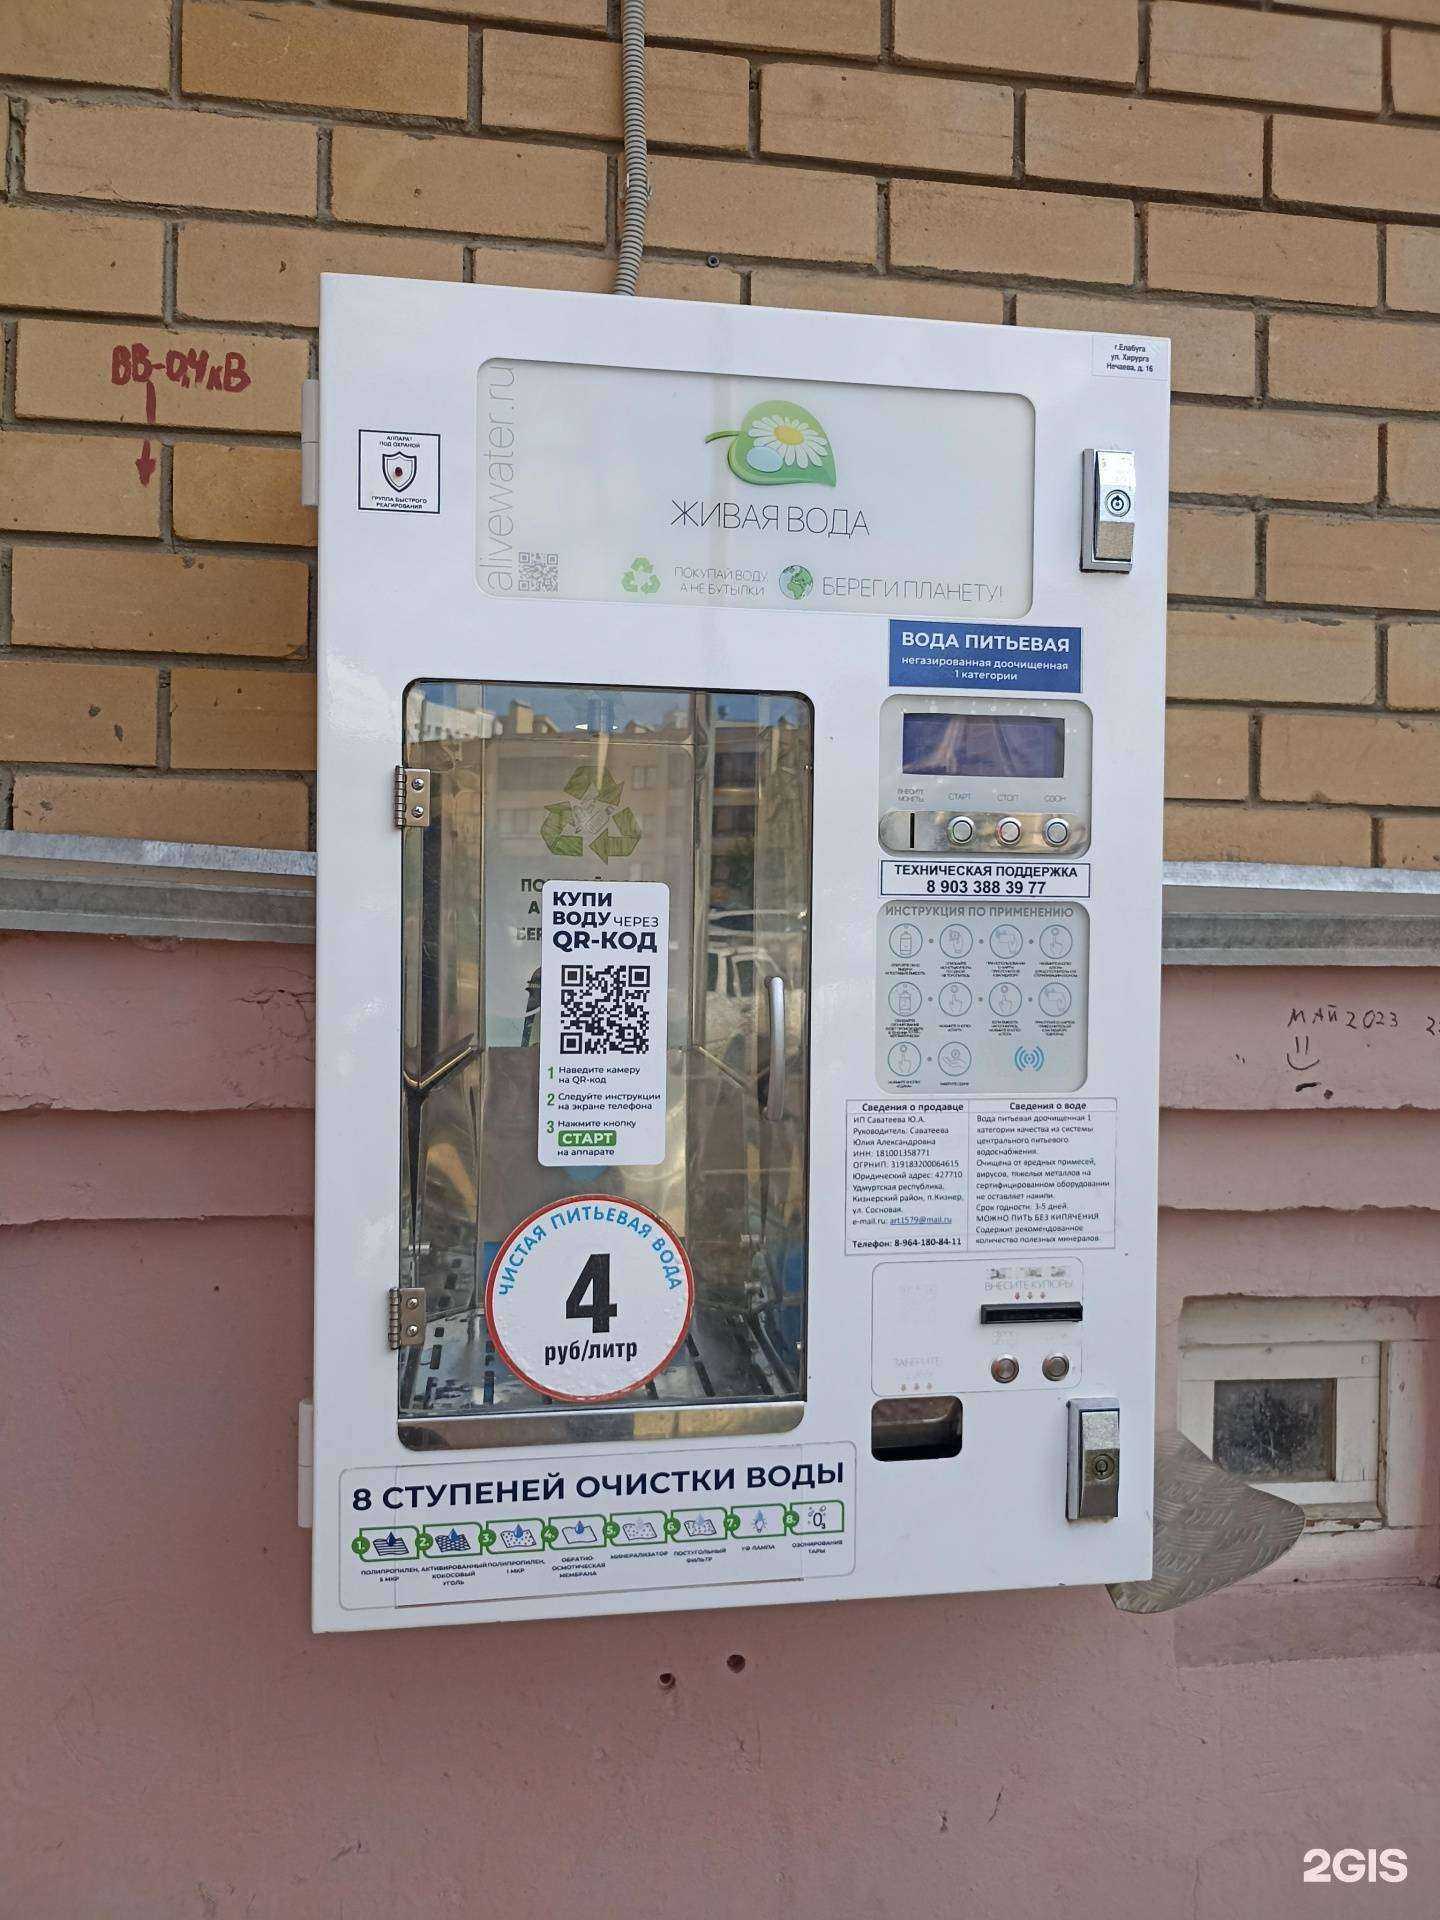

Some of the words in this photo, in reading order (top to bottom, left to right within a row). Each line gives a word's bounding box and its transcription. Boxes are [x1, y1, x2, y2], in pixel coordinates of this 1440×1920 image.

[1122, 354, 1149, 363] Хирурга
[479, 366, 515, 591] alivewater.ru
[670, 500, 779, 530] ЖИВАЯ
[787, 505, 870, 539] ВОДА
[674, 566, 734, 581] ПОКУПАЙ
[680, 583, 689, 593] А
[689, 583, 706, 594] НЕ
[708, 584, 765, 596] БУТЫЛКИ
[822, 576, 899, 599] БЕРЕГИ
[904, 580, 1002, 602] ПЛАНЕТУ!
[902, 631, 960, 650] ВОДА
[965, 634, 1070, 653] ПИТЬЕВАЯ
[902, 656, 991, 669] негазированная
[993, 660, 1069, 671] доочищенная
[961, 672, 1018, 681] категории
[948, 792, 973, 801] СТАРТ
[895, 864, 992, 877] ТЕХНИЧЕСКАЯ
[996, 866, 1078, 879] ПОДДЕРЖКА
[926, 880, 935, 893] 8
[940, 880, 968, 893] 903
[973, 881, 1000, 894] 388
[1006, 881, 1024, 894] 39
[1029, 881, 1047, 894] 77
[553, 892, 612, 907] КУПИ
[886, 906, 965, 918] ИНСТРУКЦИЯ
[969, 907, 986, 917] ПО
[990, 907, 1074, 918] ПРИМЕНЕНИЮ
[553, 911, 612, 928] ВОДУ
[613, 916, 659, 927] ЧЕРЕЗ
[553, 930, 658, 953] QR-КОД
[1346, 1010, 1398, 1029] 2023
[548, 1066, 554, 1079] 1
[559, 1067, 604, 1075] Наведите
[606, 1067, 640, 1075] камеру
[572, 1076, 607, 1084] QR-код
[547, 1094, 555, 1106] 2
[558, 1093, 602, 1102] Следуйте
[608, 1103, 652, 1111] телефона
[862, 1103, 908, 1112] Сведения
[918, 1104, 964, 1112] продавце
[1010, 1102, 1054, 1110] Сведения
[907, 1115, 926, 1123] Ю.А.
[977, 1115, 996, 1123] Вода
[547, 1121, 555, 1133] 3
[853, 1128, 908, 1136] Руководитель:
[562, 1133, 613, 1144] СТАРТ
[876, 1139, 936, 1147] Александровна
[977, 1137, 1030, 1145] центрального
[571, 1149, 615, 1157] аппарате
[977, 1148, 1038, 1156] водоснабжения.
[1023, 1159, 1056, 1167] вредных
[1057, 1158, 1096, 1166] примесей,
[853, 1172, 907, 1181] Юридический
[852, 1184, 896, 1192] Удмуртская
[976, 1181, 1054, 1190] сертифицированном
[852, 1194, 898, 1203] Кизнерский
[1015, 1225, 1083, 1233] рекомендованное
[853, 1240, 892, 1249] Телефон:
[894, 1238, 961, 1247] 8-964-180-84-11
[498, 1225, 548, 1296] ЧИСТАЯ
[550, 1206, 653, 1238] ПИТЬЕВАЯ
[652, 1237, 682, 1290] ВОДА
[565, 1253, 618, 1334] 4
[544, 1339, 638, 1365] руб/литр
[352, 1488, 372, 1511] 8
[382, 1471, 565, 1509] СТУПЕНЕЙ
[575, 1467, 735, 1499] ОЧИСТКИ
[747, 1461, 843, 1490] ВОДЫ
[610, 1551, 668, 1559] МИНЕРАЛИЗАТОР
[674, 1548, 726, 1556] ПОСТУГОЛЬНЫЙ
[361, 1567, 420, 1576] ПОЛИПРОПИЛЕН,
[421, 1563, 487, 1572] АКТИВИРОВАННЫЙ
[552, 1563, 606, 1571] ОСМОТИЧЕСКАЯ
[432, 1571, 476, 1579] КОКОСОВЫЙ
